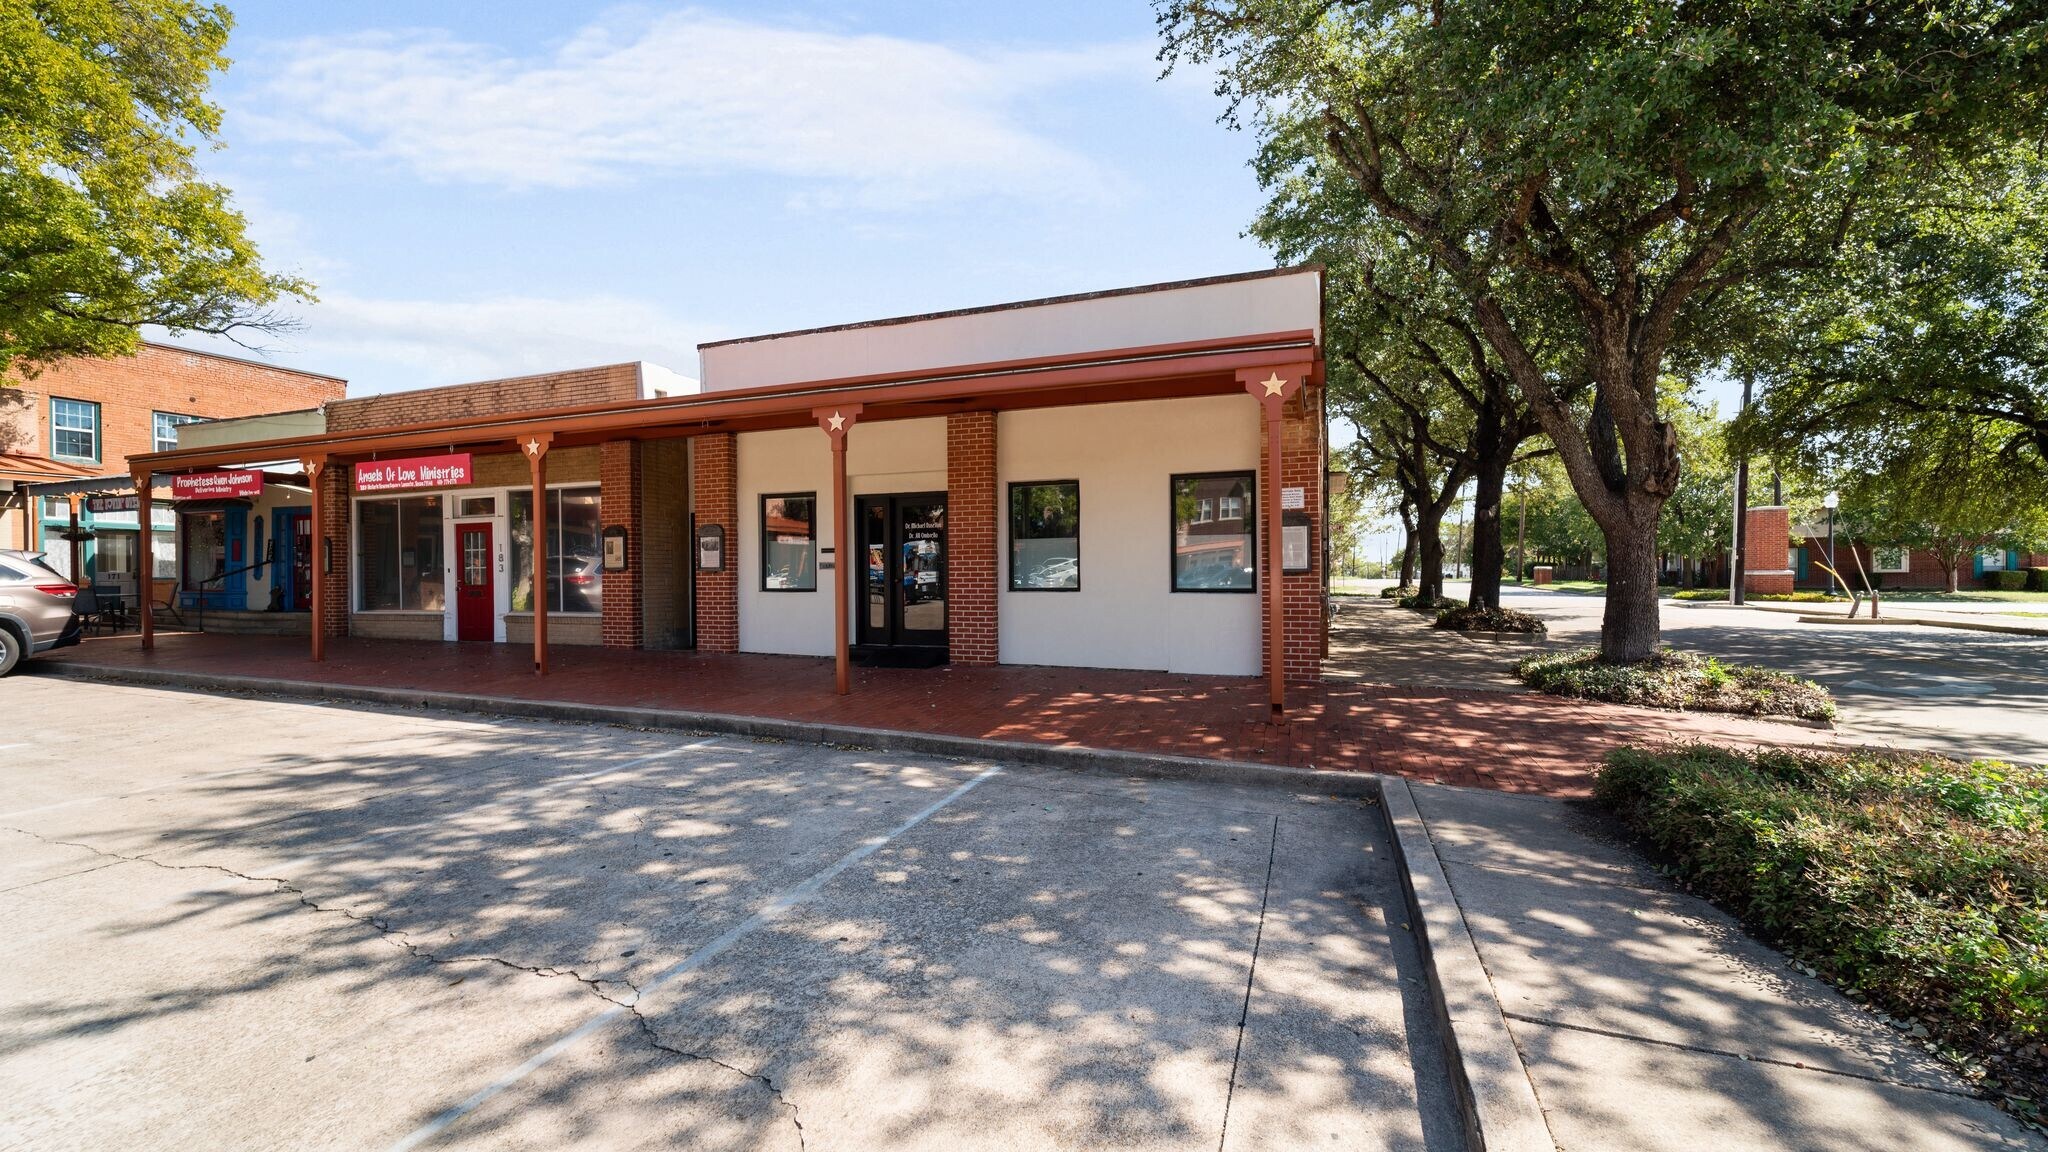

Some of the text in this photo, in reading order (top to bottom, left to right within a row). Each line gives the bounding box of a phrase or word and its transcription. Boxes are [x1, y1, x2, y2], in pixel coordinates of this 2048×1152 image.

[176, 476, 214, 488] Prophetess
[228, 473, 253, 485] Johnson
[358, 465, 465, 484] Angels Of Love Ministries
[107, 572, 120, 580] 171
